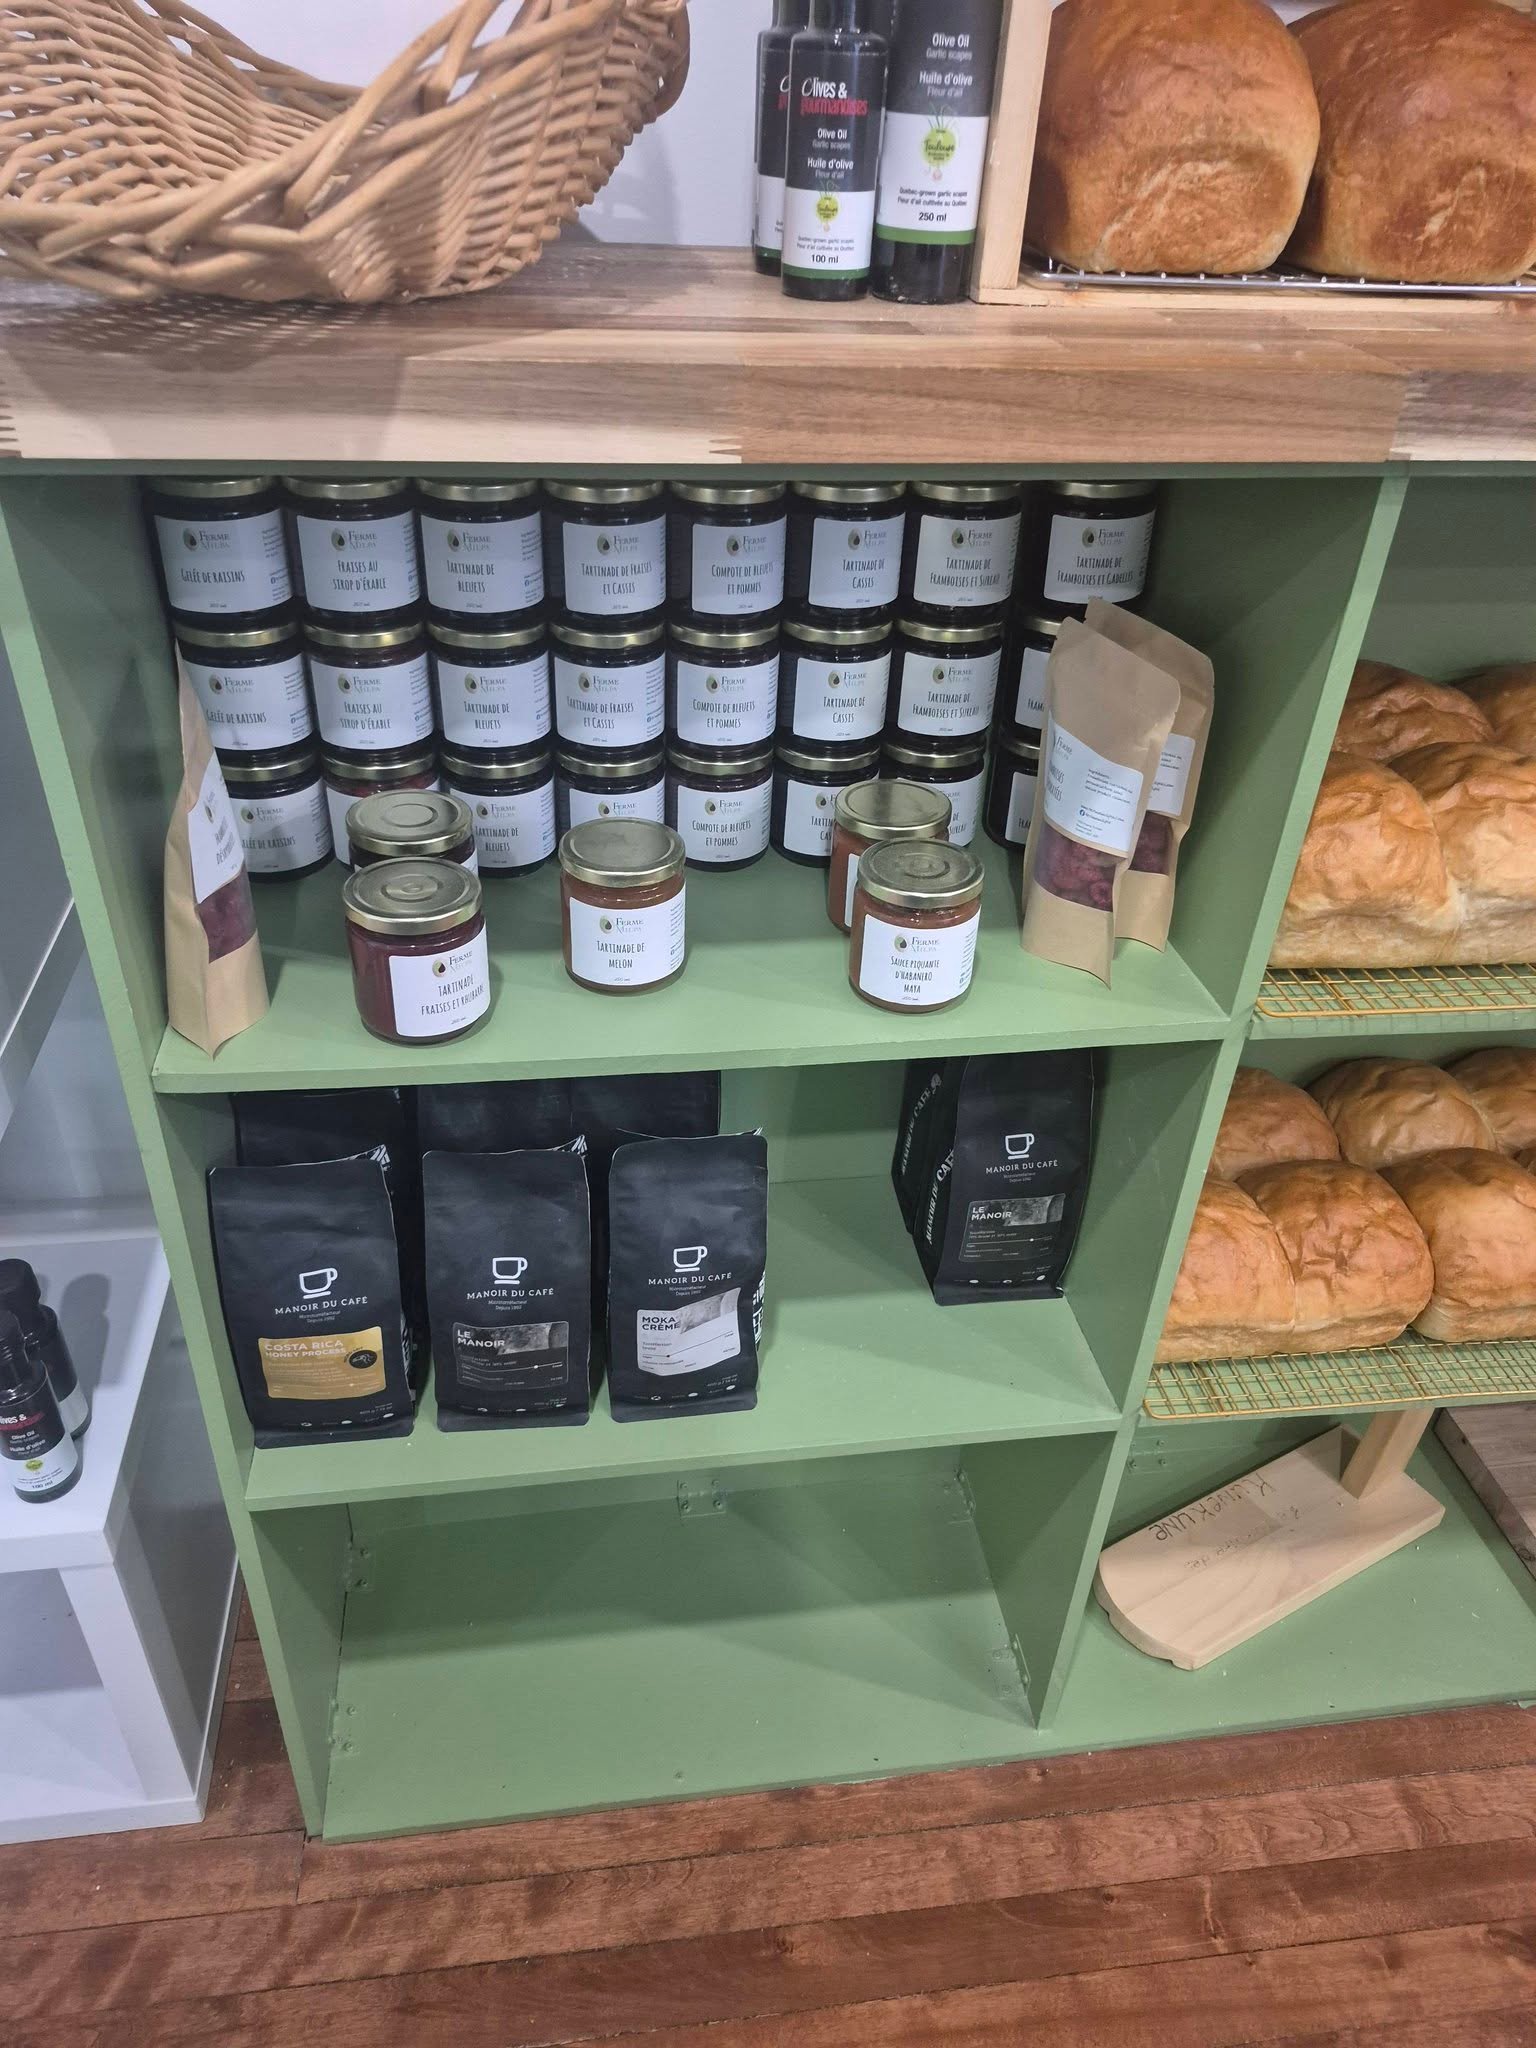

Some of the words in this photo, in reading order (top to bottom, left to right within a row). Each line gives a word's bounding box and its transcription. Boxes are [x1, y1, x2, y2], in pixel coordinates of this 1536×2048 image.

[932, 33, 956, 47] Olive
[958, 34, 970, 48] Oil
[926, 48, 947, 59] Garlic
[919, 71, 942, 84] Huile
[944, 72, 973, 86] d'olive
[801, 77, 836, 98] Olives
[838, 82, 848, 98] &
[927, 86, 946, 96] Fleur
[818, 128, 836, 140] Olive
[838, 129, 848, 140] Oil
[808, 157, 826, 168] Huile
[828, 158, 854, 170] d'olive
[918, 212, 934, 221] 250
[812, 254, 826, 262] 100
[338, 560, 366, 574] FRAISES
[368, 560, 378, 573] AU
[447, 560, 483, 576] TARTINADE
[485, 564, 494, 576] DE
[842, 558, 878, 571] TARTINADE
[878, 558, 885, 570] DE
[946, 557, 982, 570] TARTINADE
[984, 559, 991, 570] DE
[1076, 556, 1113, 568] TARTINADE
[1114, 557, 1122, 568] DE
[581, 562, 618, 577] TARTINADE
[621, 565, 629, 577] DE
[630, 562, 653, 576] FRAISES
[712, 564, 742, 578] COMPOTE
[744, 565, 752, 576] DE
[202, 570, 212, 582] DE
[212, 570, 245, 582] RAISINS
[930, 572, 968, 587] FRAMBOISES
[970, 575, 978, 587] ET
[1057, 570, 1096, 586] FRAMBOISES
[332, 578, 354, 590] SIROP
[355, 577, 387, 591] D'ÉRABLE
[457, 580, 486, 593] BLEUETS
[603, 583, 611, 594] ET
[612, 582, 636, 594] CASSIS
[728, 584, 736, 595] ET
[736, 582, 761, 594] POMMES
[852, 576, 874, 589] CASSIS
[823, 696, 858, 708] TARTINADE
[859, 696, 866, 706] DE
[928, 691, 962, 704] TARTINADE
[963, 692, 970, 702] DE
[344, 701, 371, 714] FRAISES
[372, 702, 382, 713] AU
[464, 700, 500, 714] TARTINADE
[502, 702, 510, 714] DE
[566, 696, 598, 713] TARTINADE
[600, 701, 608, 713] DE
[609, 700, 634, 713] FRAISES
[693, 699, 722, 713] COMPOTE
[722, 702, 731, 713] DE
[732, 699, 756, 713] BLEUETS
[912, 704, 948, 718] FRAMBOISES
[950, 708, 958, 718] ET
[228, 712, 236, 724] DE
[236, 712, 267, 724] RAISINS
[340, 717, 359, 730] SIROP
[360, 716, 390, 730] D'ÉRABLE
[474, 718, 502, 730] BLEUETS
[583, 716, 590, 728] ET
[592, 716, 614, 730] CASSIS
[706, 718, 714, 728] ET
[715, 718, 741, 728] POMMES
[832, 712, 854, 724] CASSIS
[475, 826, 508, 838] TARTINADE
[510, 826, 519, 837] DE
[692, 820, 718, 832] COMPOTE
[720, 823, 728, 832] DE
[730, 820, 751, 832] BLEUETS
[268, 836, 296, 848] RAISINS
[485, 842, 510, 852] BLEUETS
[706, 836, 713, 847] ET
[714, 836, 738, 846] POMMES
[616, 918, 644, 926] FERME
[597, 940, 634, 954] TARTINADE
[636, 942, 644, 952] DE
[912, 936, 940, 946] FERME
[608, 959, 632, 968] MELON
[890, 956, 909, 966] SAUCE
[910, 959, 940, 969] PIQUANTE
[895, 971, 933, 981] D'HABANERO
[438, 974, 474, 996] TARTINADE
[904, 984, 921, 993] MAYA
[422, 1001, 451, 1016] FRAISES
[452, 998, 460, 1010] ET
[986, 1164, 1020, 1174] MANOIR
[1022, 1162, 1034, 1170] DU
[1037, 1160, 1058, 1168] CAFÉ
[972, 1206, 985, 1214] LE
[972, 1212, 1012, 1220] MANOIR
[648, 1276, 688, 1285] MANOIR
[708, 1272, 732, 1281] CAFÉ
[466, 1290, 508, 1300] MANOIR
[512, 1289, 524, 1297] DU
[528, 1288, 554, 1297] CAFÉ
[275, 1303, 319, 1315] MANOIR
[322, 1300, 338, 1308] DU
[341, 1296, 368, 1306] CAFÉ
[642, 1316, 676, 1324] MOKA
[458, 1330, 470, 1338] LE
[264, 1342, 308, 1352] COSTA
[312, 1340, 344, 1350] RICA
[458, 1338, 505, 1348] MANOIR
[266, 1351, 300, 1359] HONEY
[302, 1348, 346, 1357] PROCESS
